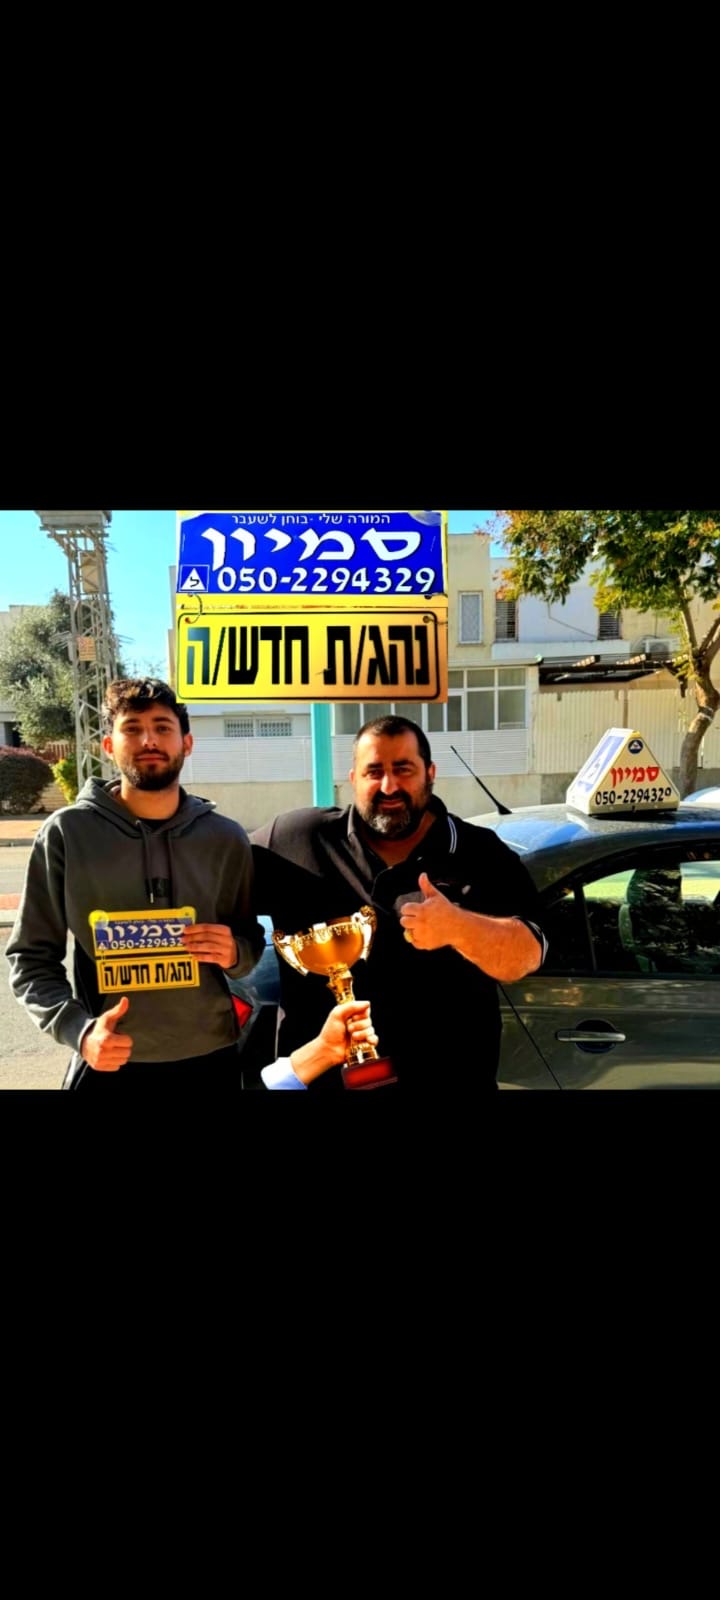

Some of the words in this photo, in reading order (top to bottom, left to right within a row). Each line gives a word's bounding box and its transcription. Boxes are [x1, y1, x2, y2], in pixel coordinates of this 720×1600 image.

[610, 766, 660, 788] סמיון
[104, 924, 185, 942] סמיון
[111, 938, 183, 949] 050-229432
[104, 964, 150, 986] חדש/ה
[155, 961, 192, 984] נהג/ת
